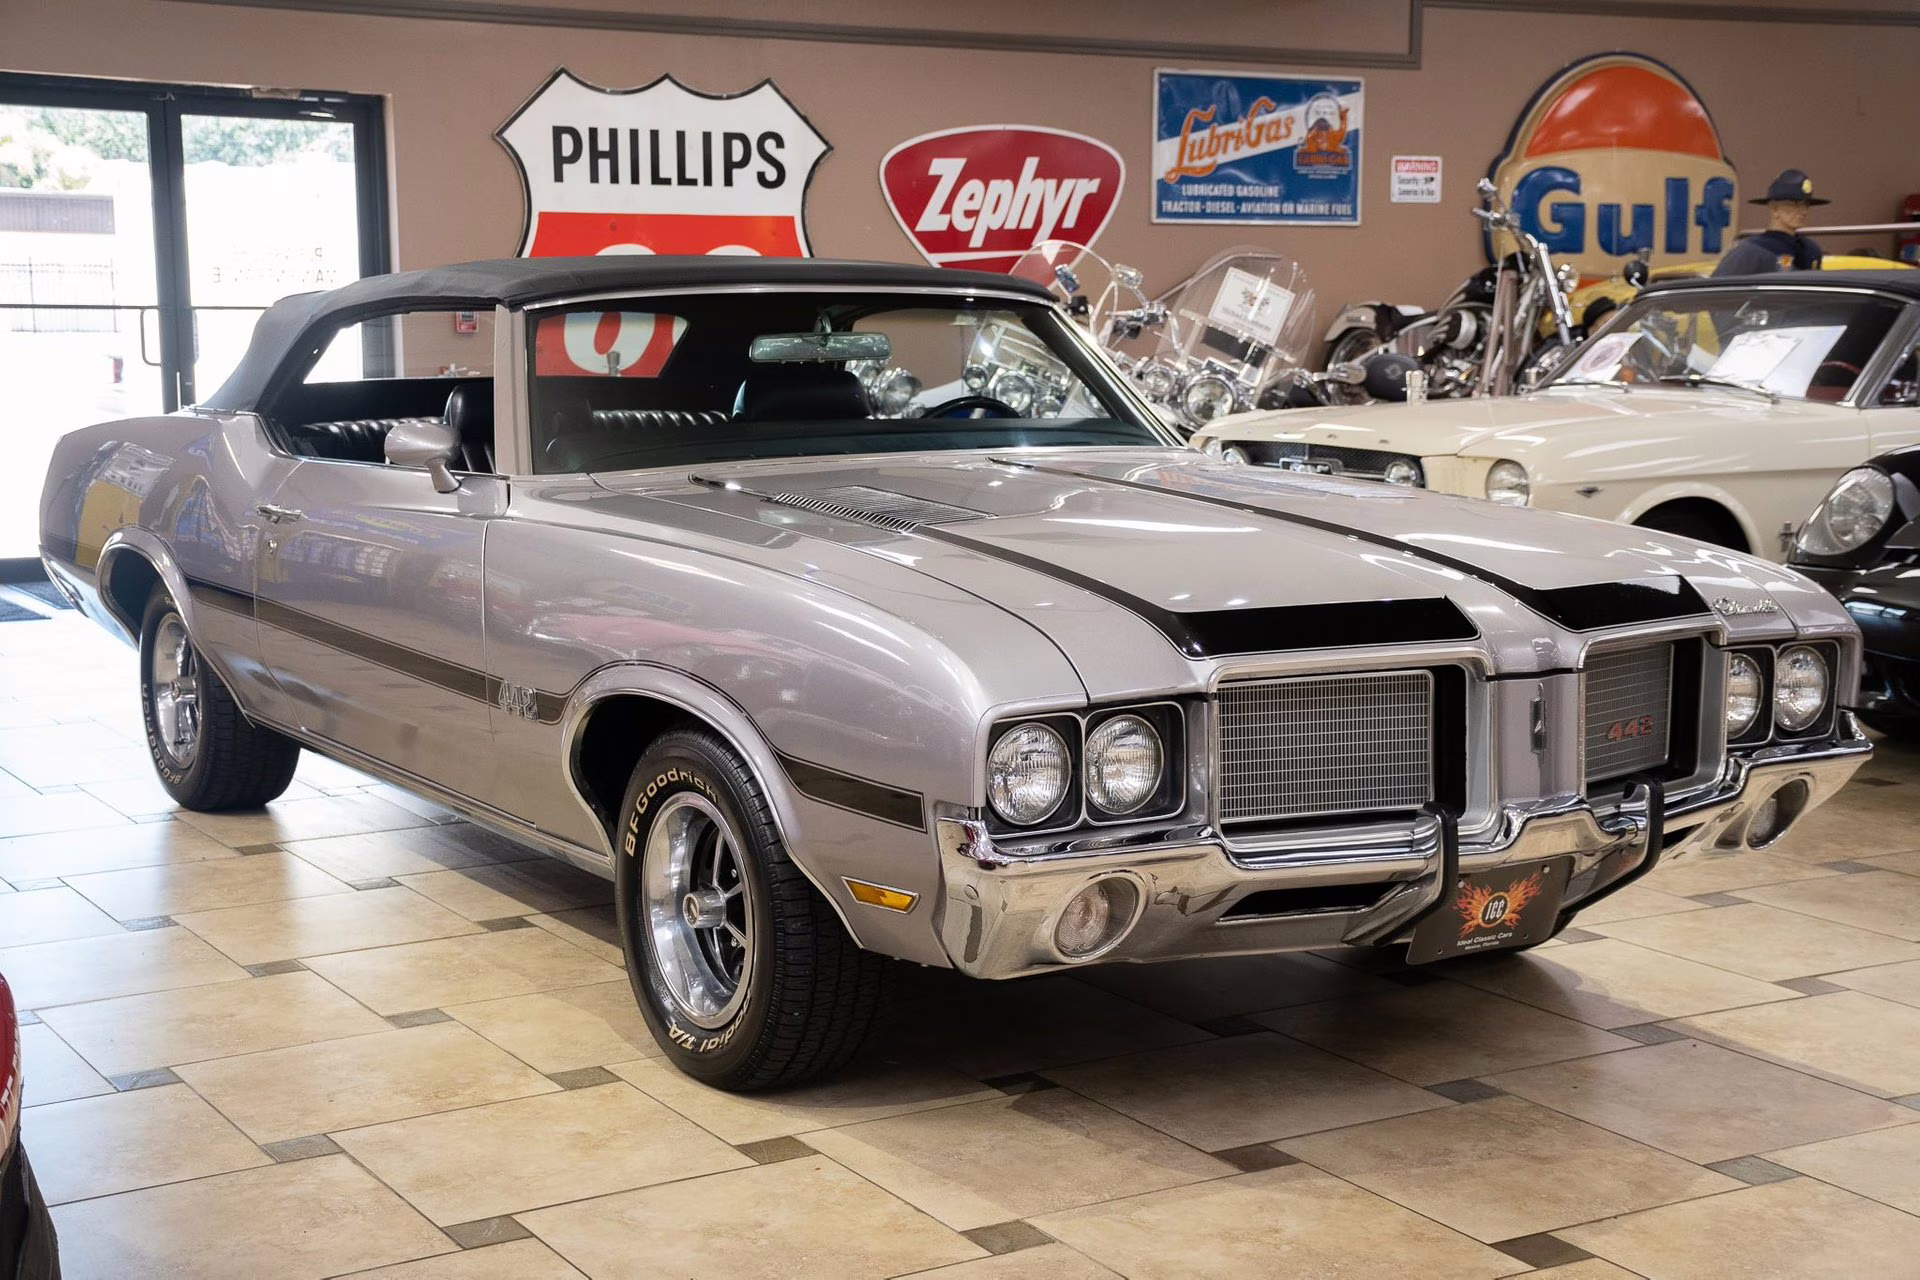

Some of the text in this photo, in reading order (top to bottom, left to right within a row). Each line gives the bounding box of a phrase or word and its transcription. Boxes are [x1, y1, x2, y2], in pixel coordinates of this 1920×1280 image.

[552, 125, 786, 189] PHILLIPS
[914, 156, 1101, 248] Zephyr
[1181, 184, 1279, 197] LUBRICATED GASOLINE
[1296, 203, 1330, 215] MARINE
[1331, 204, 1352, 215] FUEL
[1513, 166, 1735, 256] Gulf
[499, 680, 538, 720] 442
[1607, 714, 1654, 741] 442
[625, 767, 719, 857] BFGoodrich
[1457, 938, 1472, 946] Ideal
